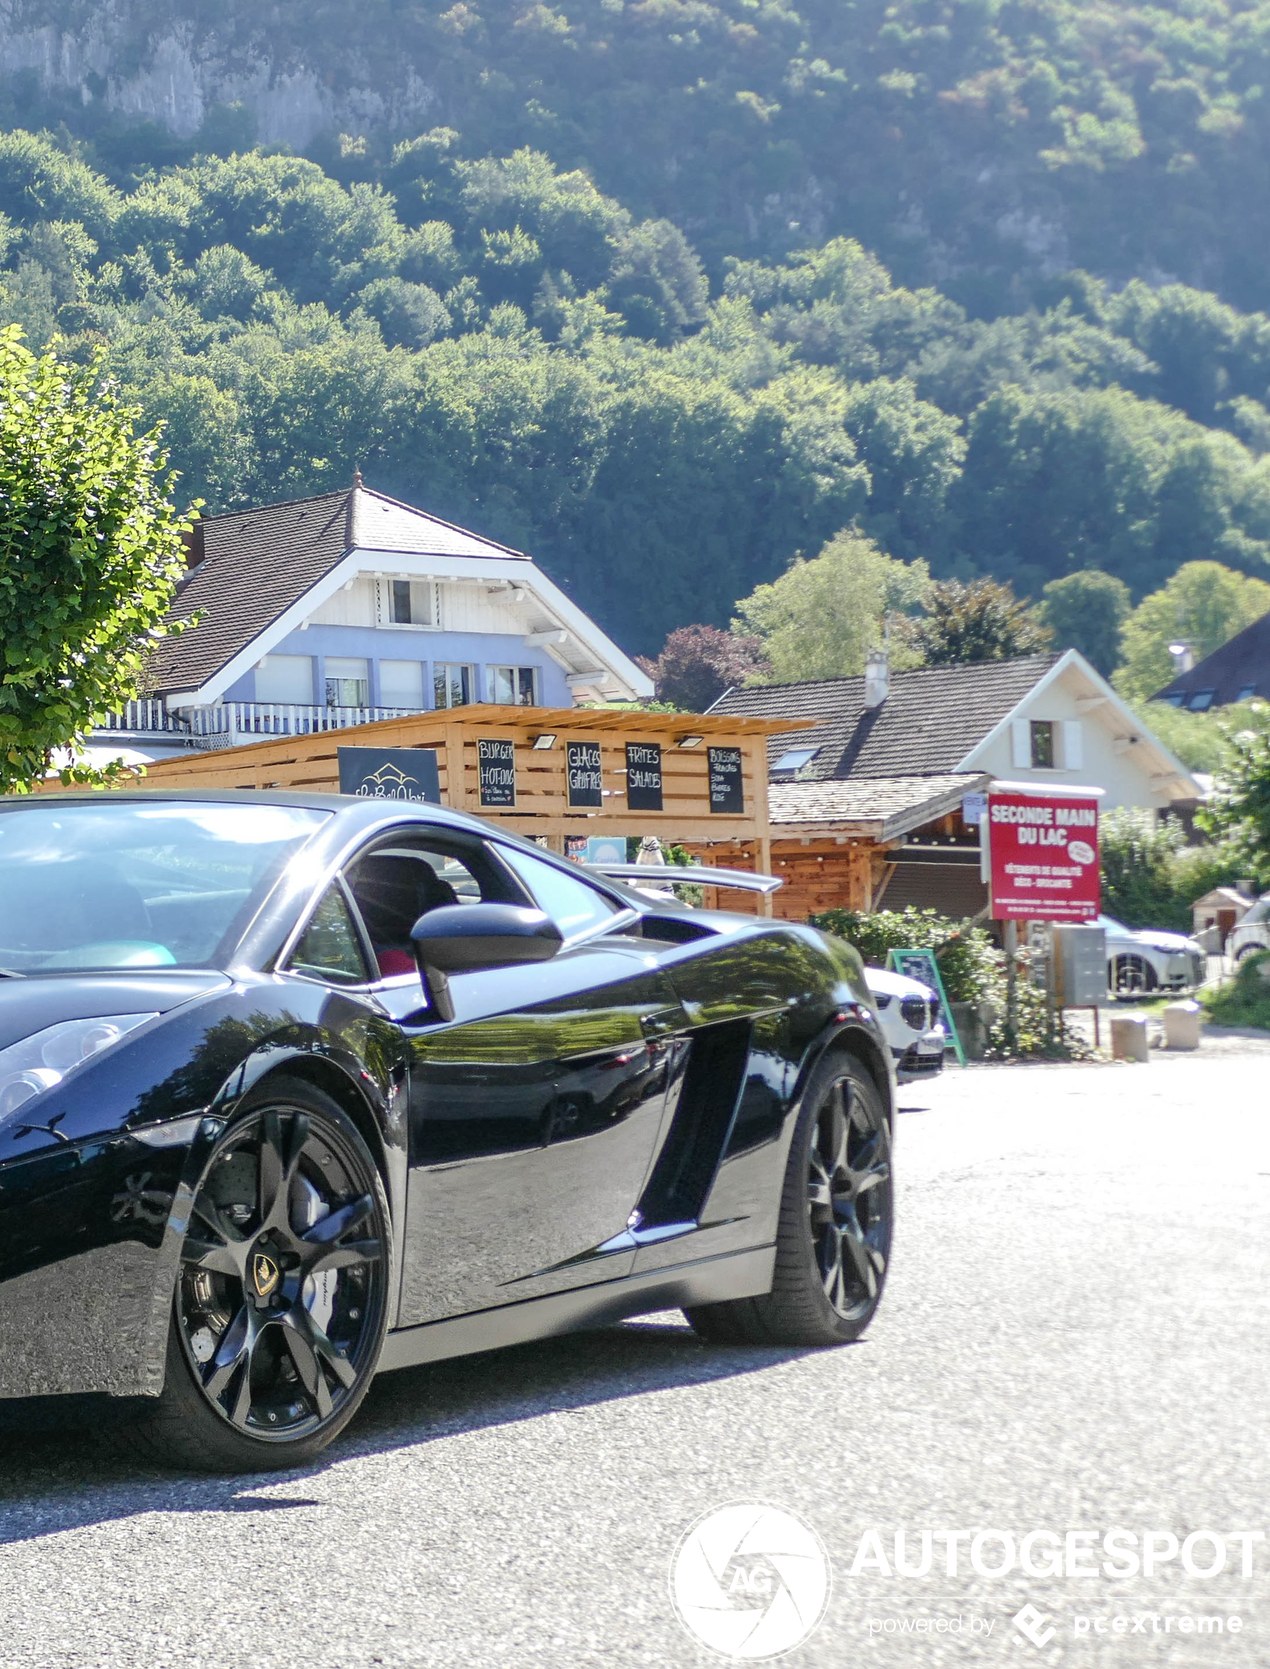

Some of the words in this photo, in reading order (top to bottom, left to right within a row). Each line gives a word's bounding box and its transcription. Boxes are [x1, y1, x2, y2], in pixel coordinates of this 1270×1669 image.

[479, 741, 514, 759] BURGER
[568, 746, 601, 769] GLACES
[991, 804, 1053, 825] SECONDE
[1055, 808, 1096, 826] MAIN
[1017, 826, 1037, 844] DU
[1039, 828, 1068, 846] LAC
